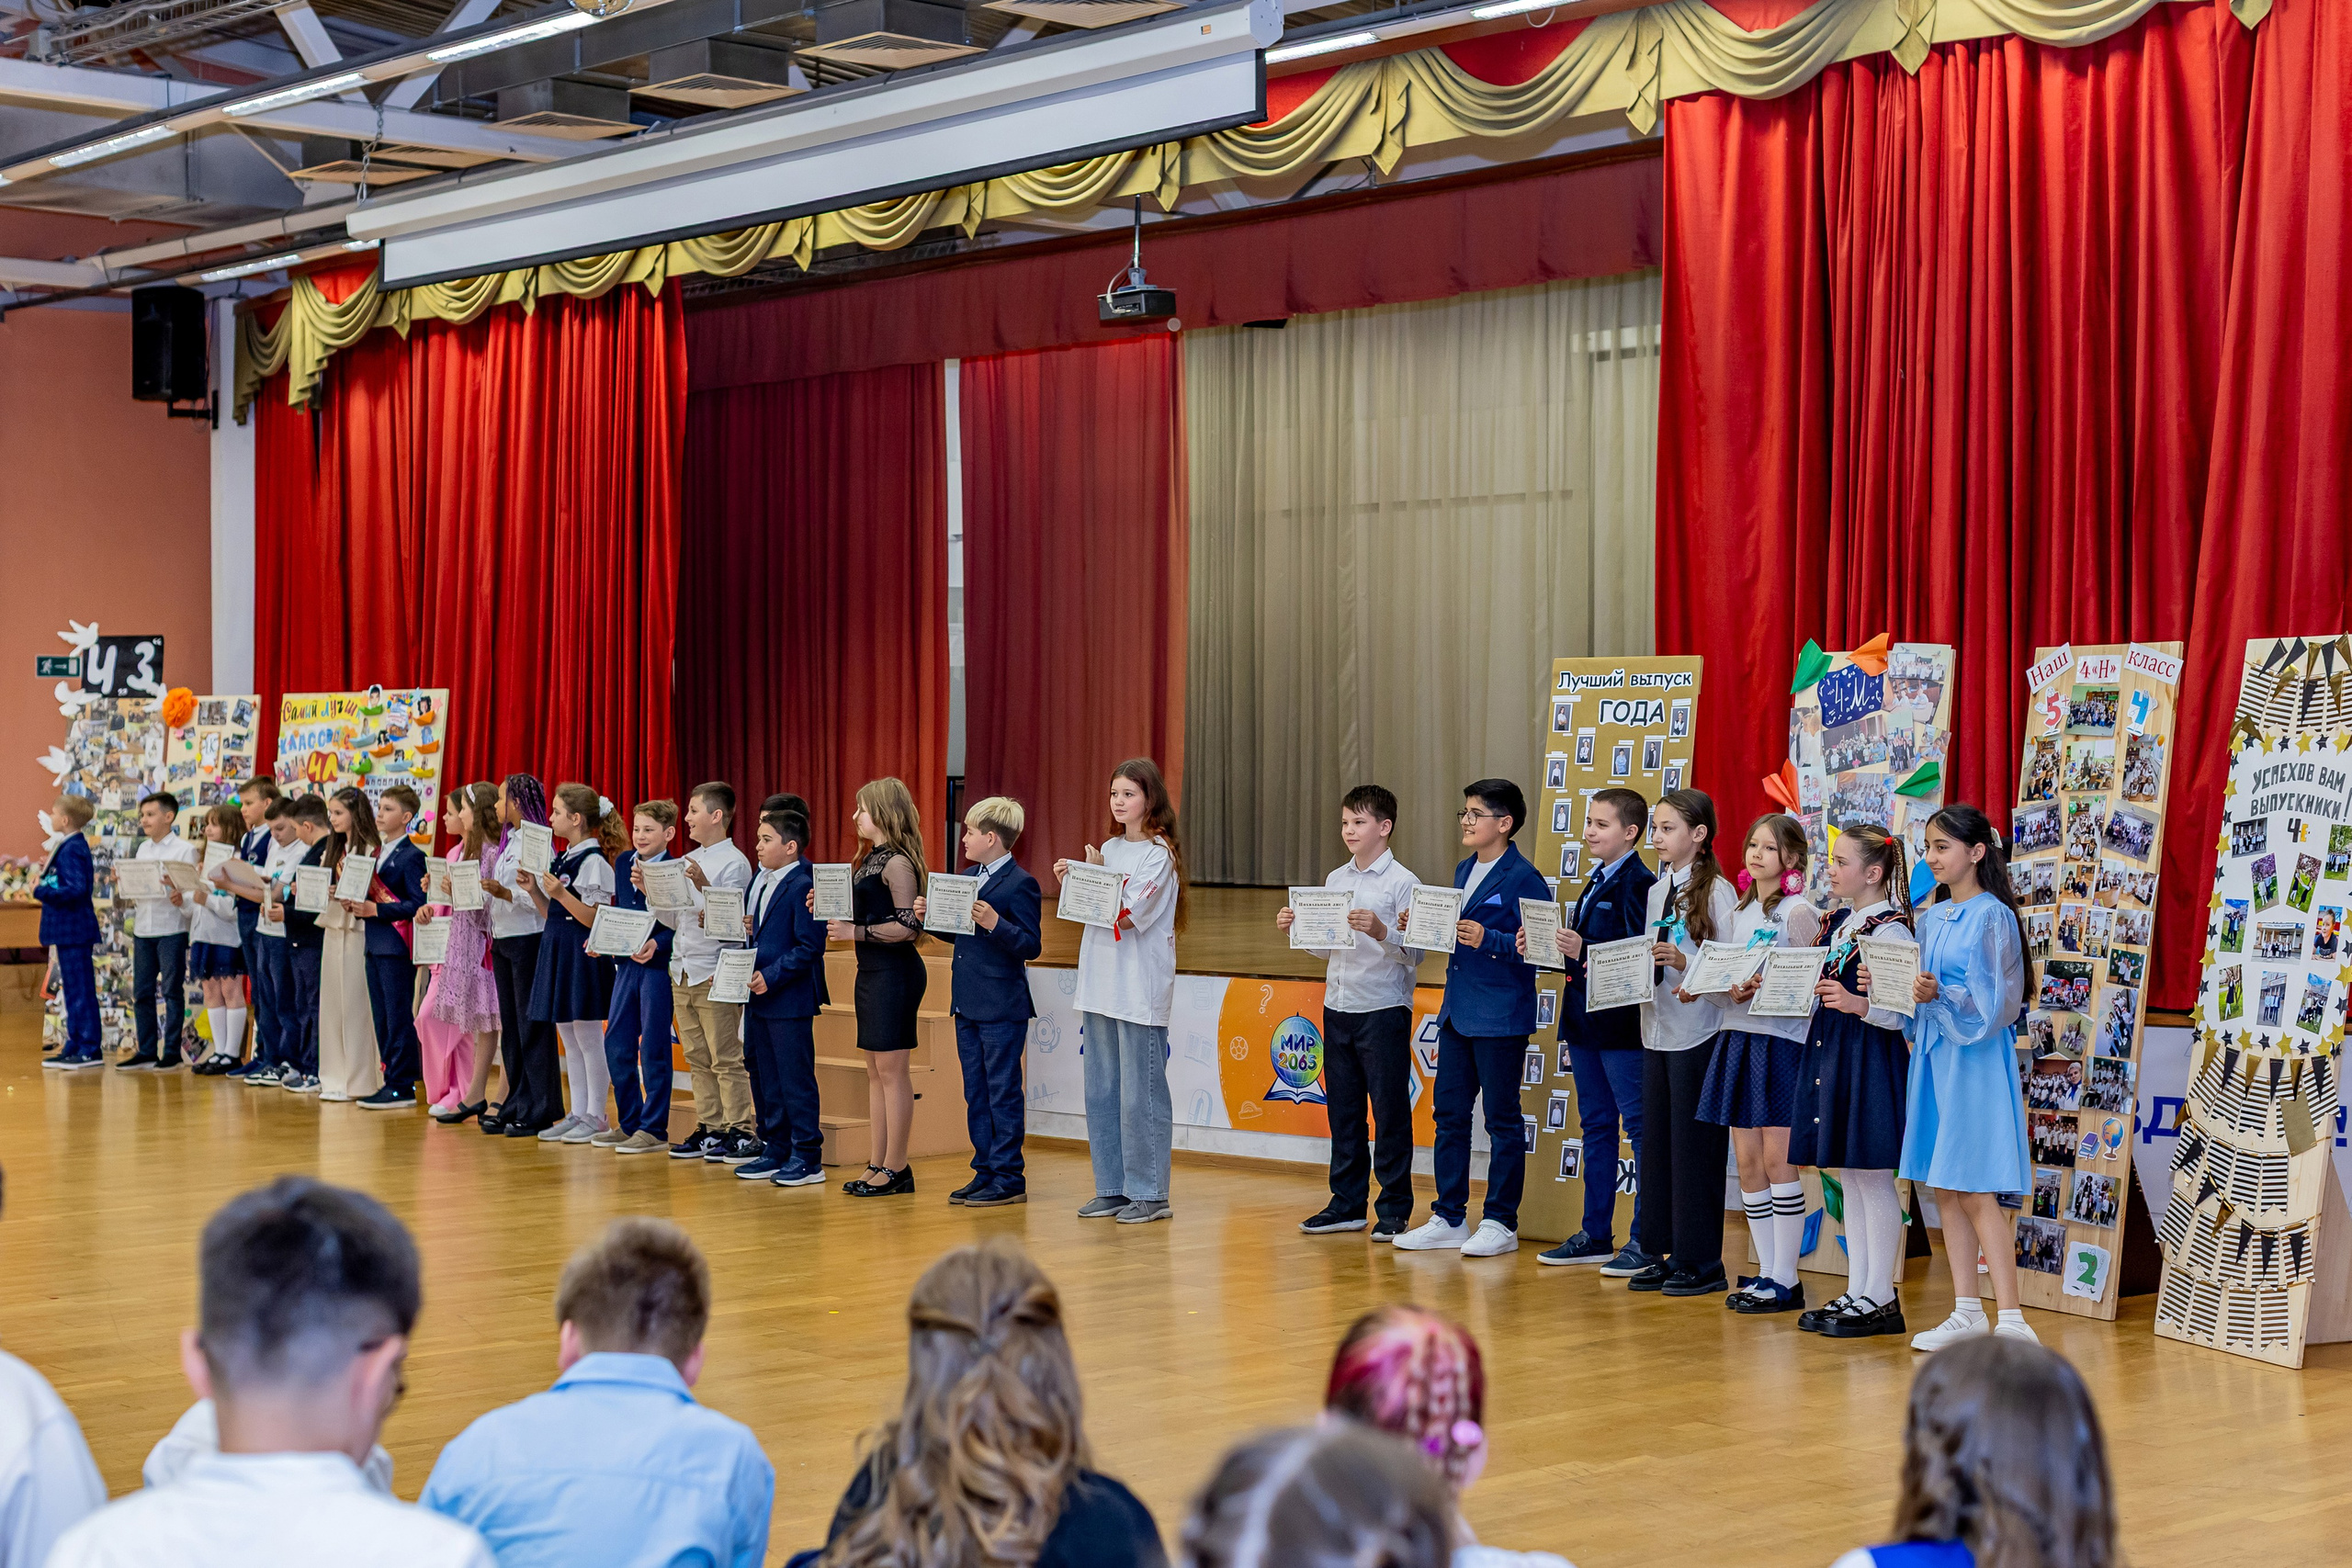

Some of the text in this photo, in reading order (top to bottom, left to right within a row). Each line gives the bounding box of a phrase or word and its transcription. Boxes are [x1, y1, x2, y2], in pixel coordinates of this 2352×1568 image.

[2030, 651, 2068, 687] Наш
[2127, 650, 2176, 678] класс
[1558, 670, 1691, 693] Лучший выпуск
[1600, 701, 1665, 726] ГОДА
[2252, 762, 2346, 795] УСПЕХОВ ВАМ
[1280, 1034, 1316, 1053] МИР
[1278, 1053, 1317, 1071] 2065
[2076, 1251, 2098, 1287] 2
